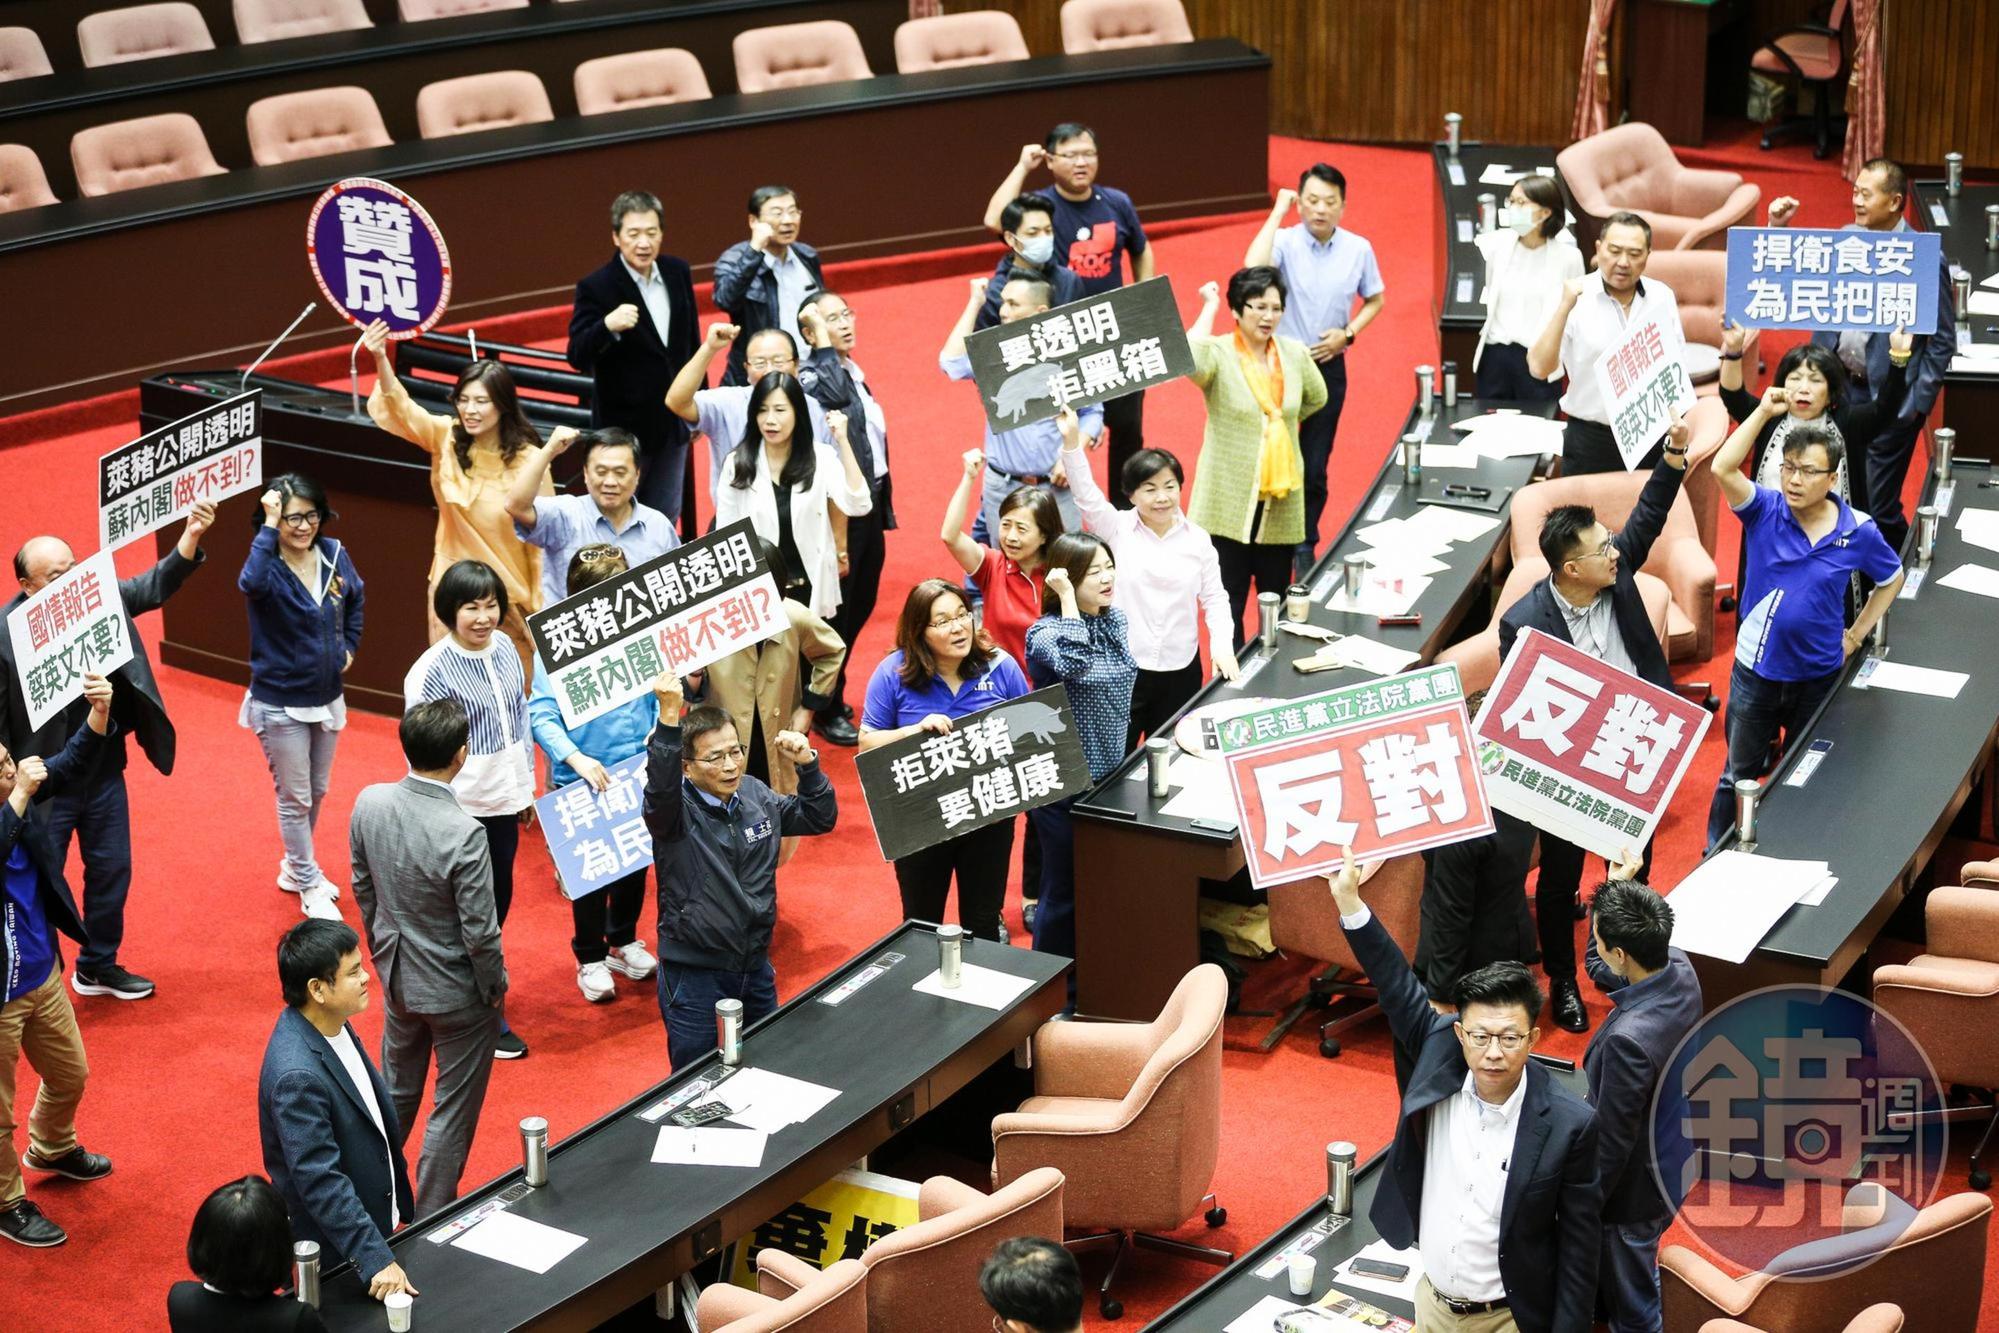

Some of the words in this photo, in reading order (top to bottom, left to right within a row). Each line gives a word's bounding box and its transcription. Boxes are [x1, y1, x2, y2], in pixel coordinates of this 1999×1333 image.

[336, 196, 420, 321] 贊成
[1752, 233, 1914, 276] 捍衛食安
[998, 301, 1120, 372] 要透明
[1744, 278, 1917, 326] 為民把關
[1046, 337, 1168, 407] 拒黑箱
[1606, 322, 1665, 399] 國情報告
[106, 401, 255, 498] 萊豬公開透明
[26, 571, 103, 653] 國情報告
[541, 531, 758, 662] 萊豬公開透明
[26, 613, 121, 712] 蔡英文不要?
[1253, 670, 1460, 741] 民進黨立法院黨團
[1500, 653, 1686, 795] 反對
[890, 716, 1015, 793] 拒萊豬
[937, 751, 1064, 829] 要健康
[1253, 722, 1468, 863] 反對
[1500, 758, 1647, 839] 民進黨立法院黨團
